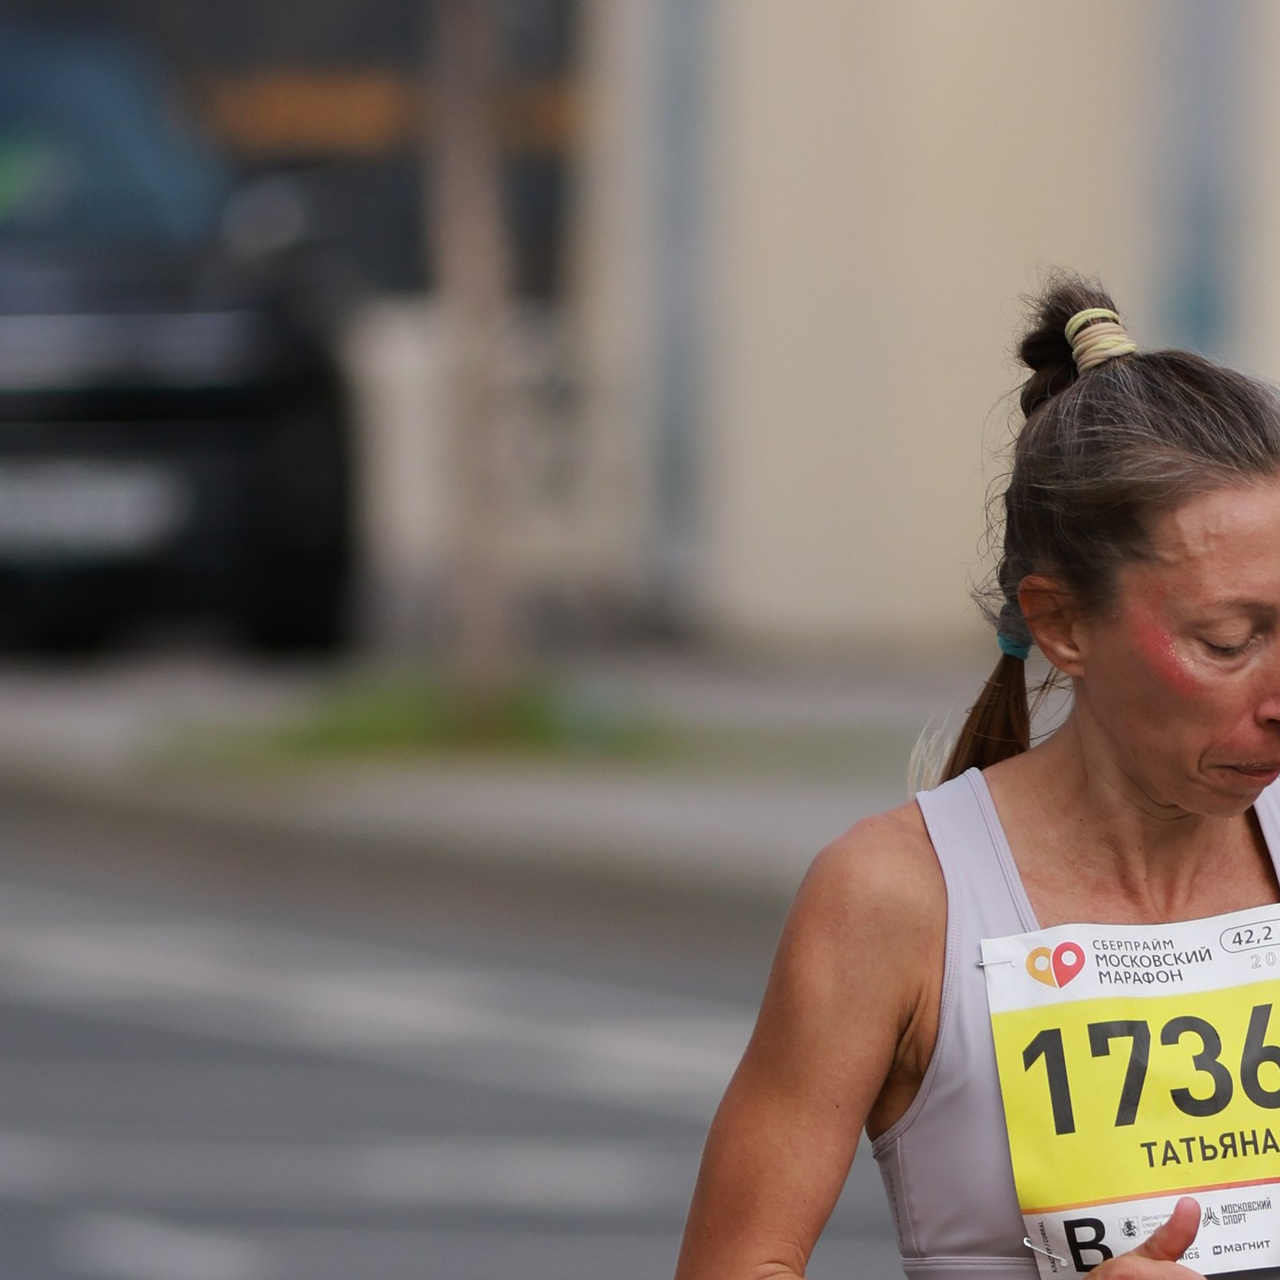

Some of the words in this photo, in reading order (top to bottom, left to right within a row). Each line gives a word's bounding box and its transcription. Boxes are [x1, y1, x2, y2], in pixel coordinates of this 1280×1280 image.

[1232, 926, 1273, 946] 42,2
[1092, 938, 1175, 952] СБЕРПРАЙМ
[1095, 946, 1213, 968] МОСКОВСКИЙ
[1098, 969, 1183, 984] МАРАФОН
[1140, 1128, 1280, 1168] ТАТЬЯНА
[1221, 1197, 1272, 1214] МОСКОВСКИЙ
[1222, 1213, 1247, 1226] СПОРТ
